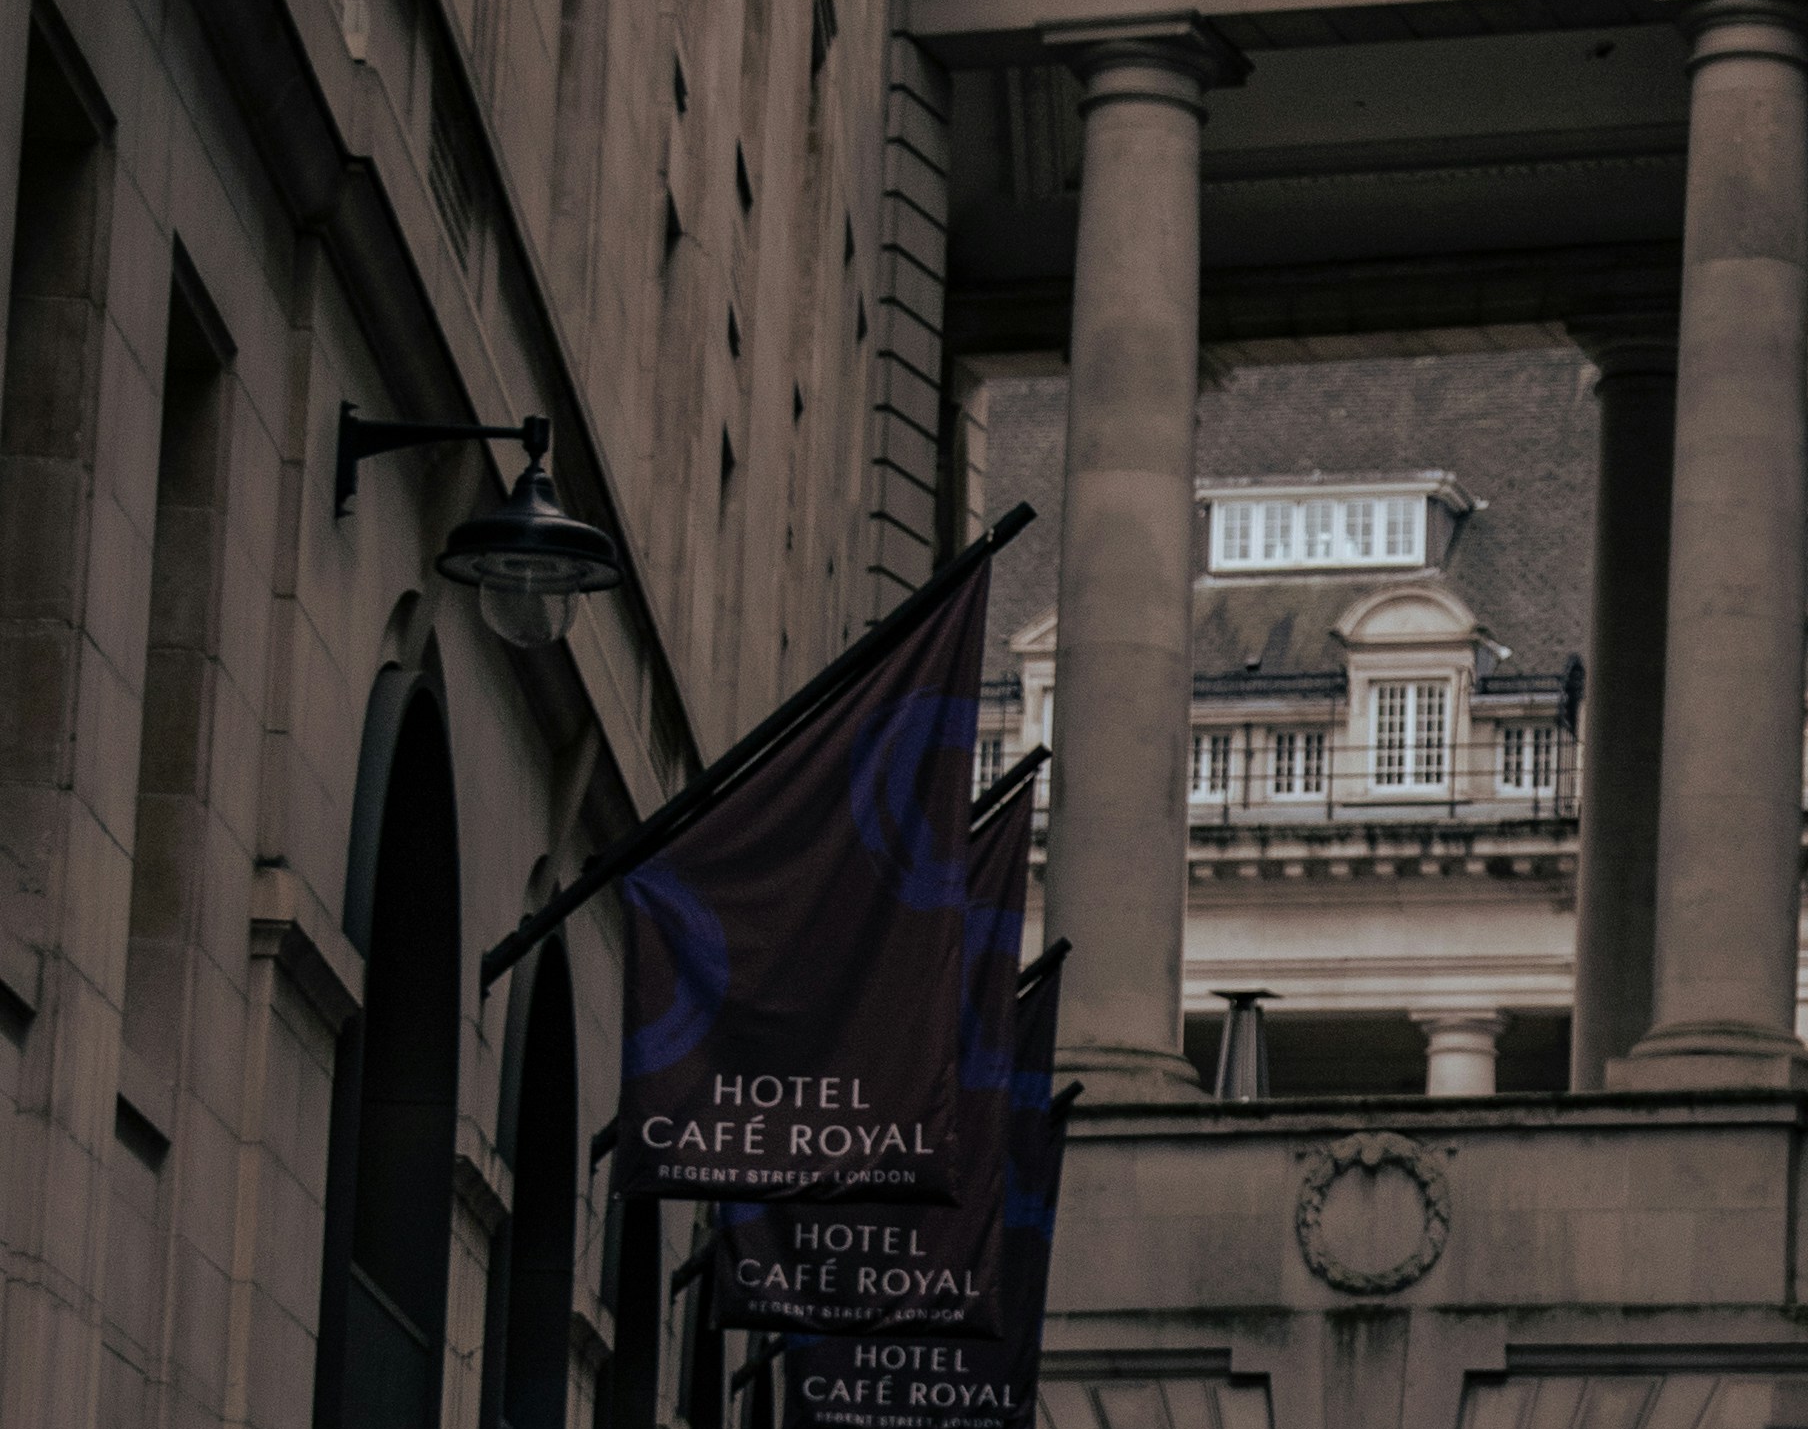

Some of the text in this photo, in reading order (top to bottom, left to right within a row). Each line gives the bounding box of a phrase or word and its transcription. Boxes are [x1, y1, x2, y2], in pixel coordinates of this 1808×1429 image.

[713, 1073, 871, 1110] HOTEL
[641, 1114, 935, 1157] CAFÉ ROYAL
[656, 1164, 740, 1183] REGENT
[832, 1169, 916, 1184] LONDON
[794, 1222, 927, 1256] HOTEL
[736, 1257, 981, 1297] CAFÉ ROYAL
[853, 1344, 970, 1373] HOTEL
[802, 1374, 1018, 1409] CAFÉ ROYAL
